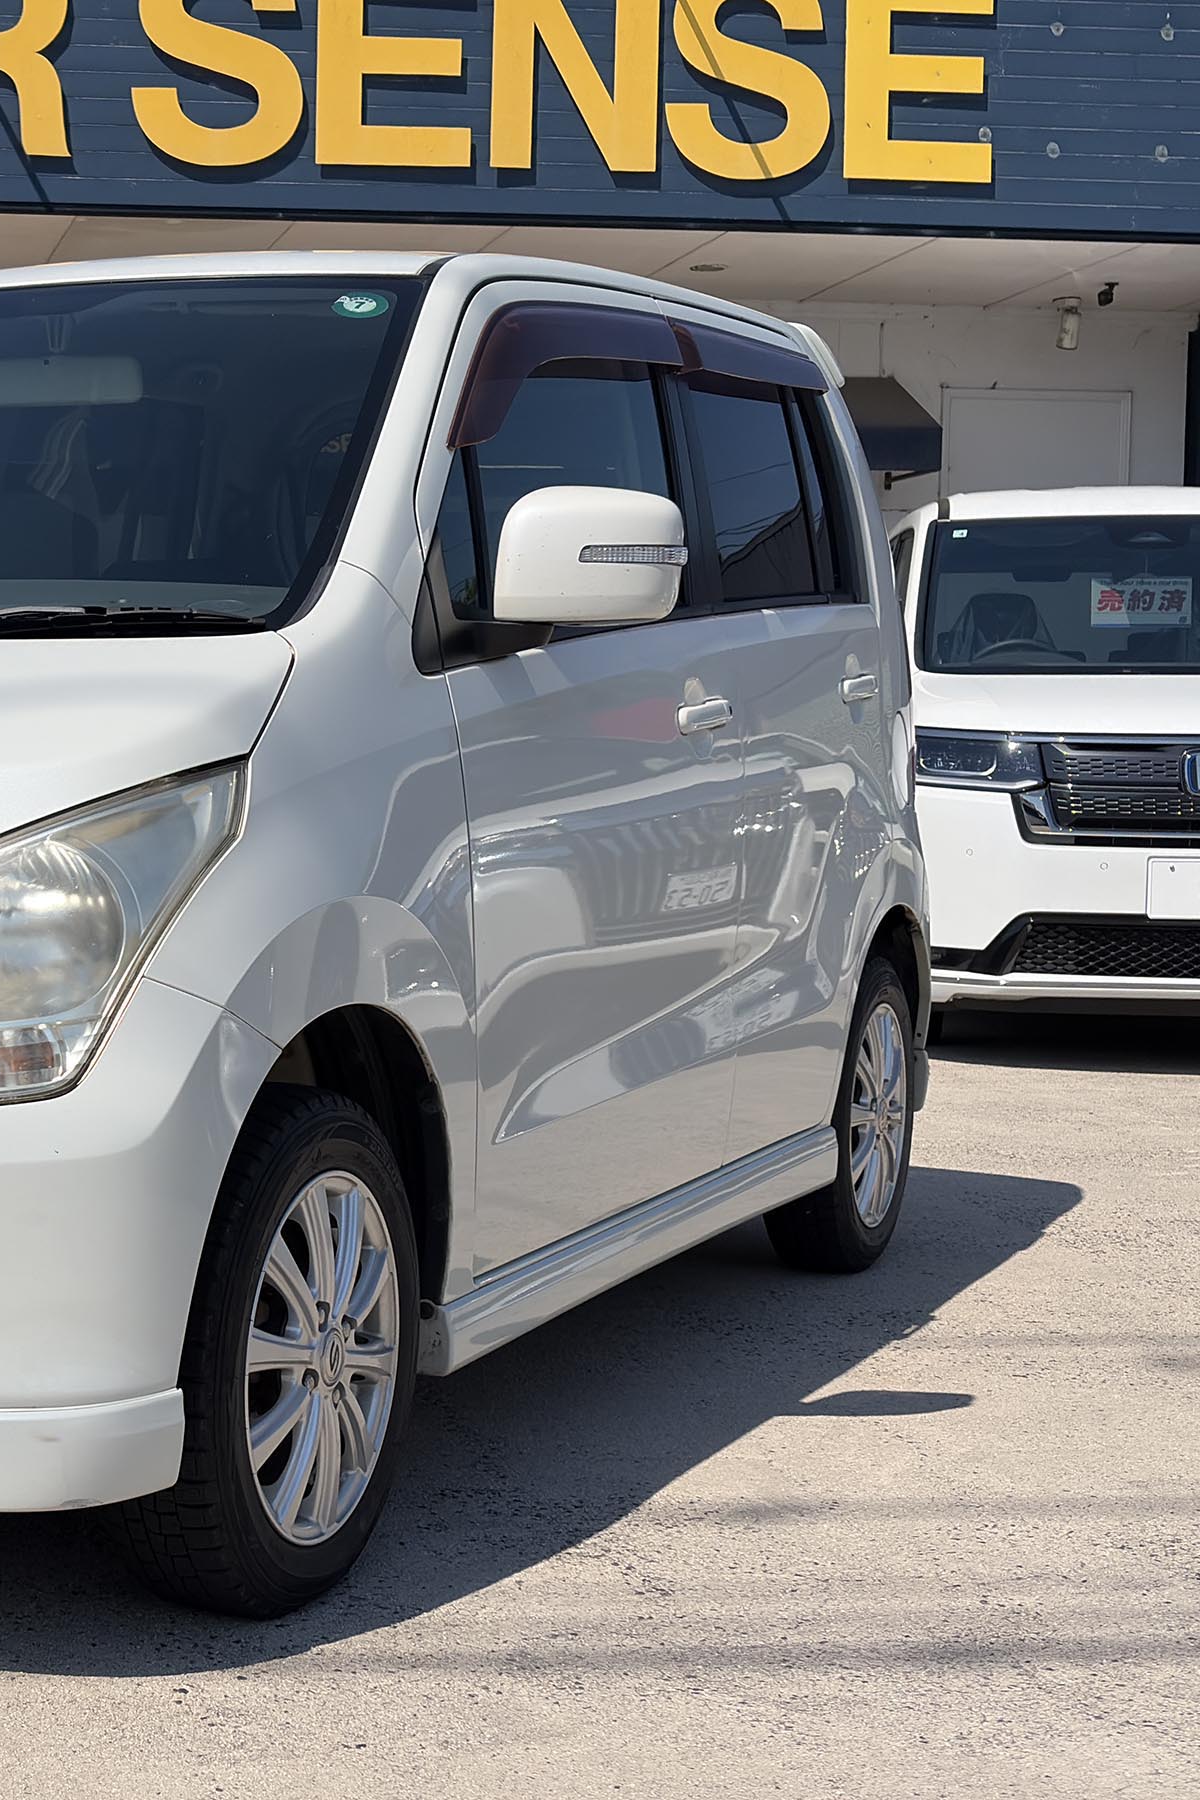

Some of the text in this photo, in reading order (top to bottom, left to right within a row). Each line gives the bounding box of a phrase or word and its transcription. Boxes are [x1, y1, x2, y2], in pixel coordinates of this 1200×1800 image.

[131, 0, 994, 184] SENSE
[1098, 589, 1186, 612] 売約済
